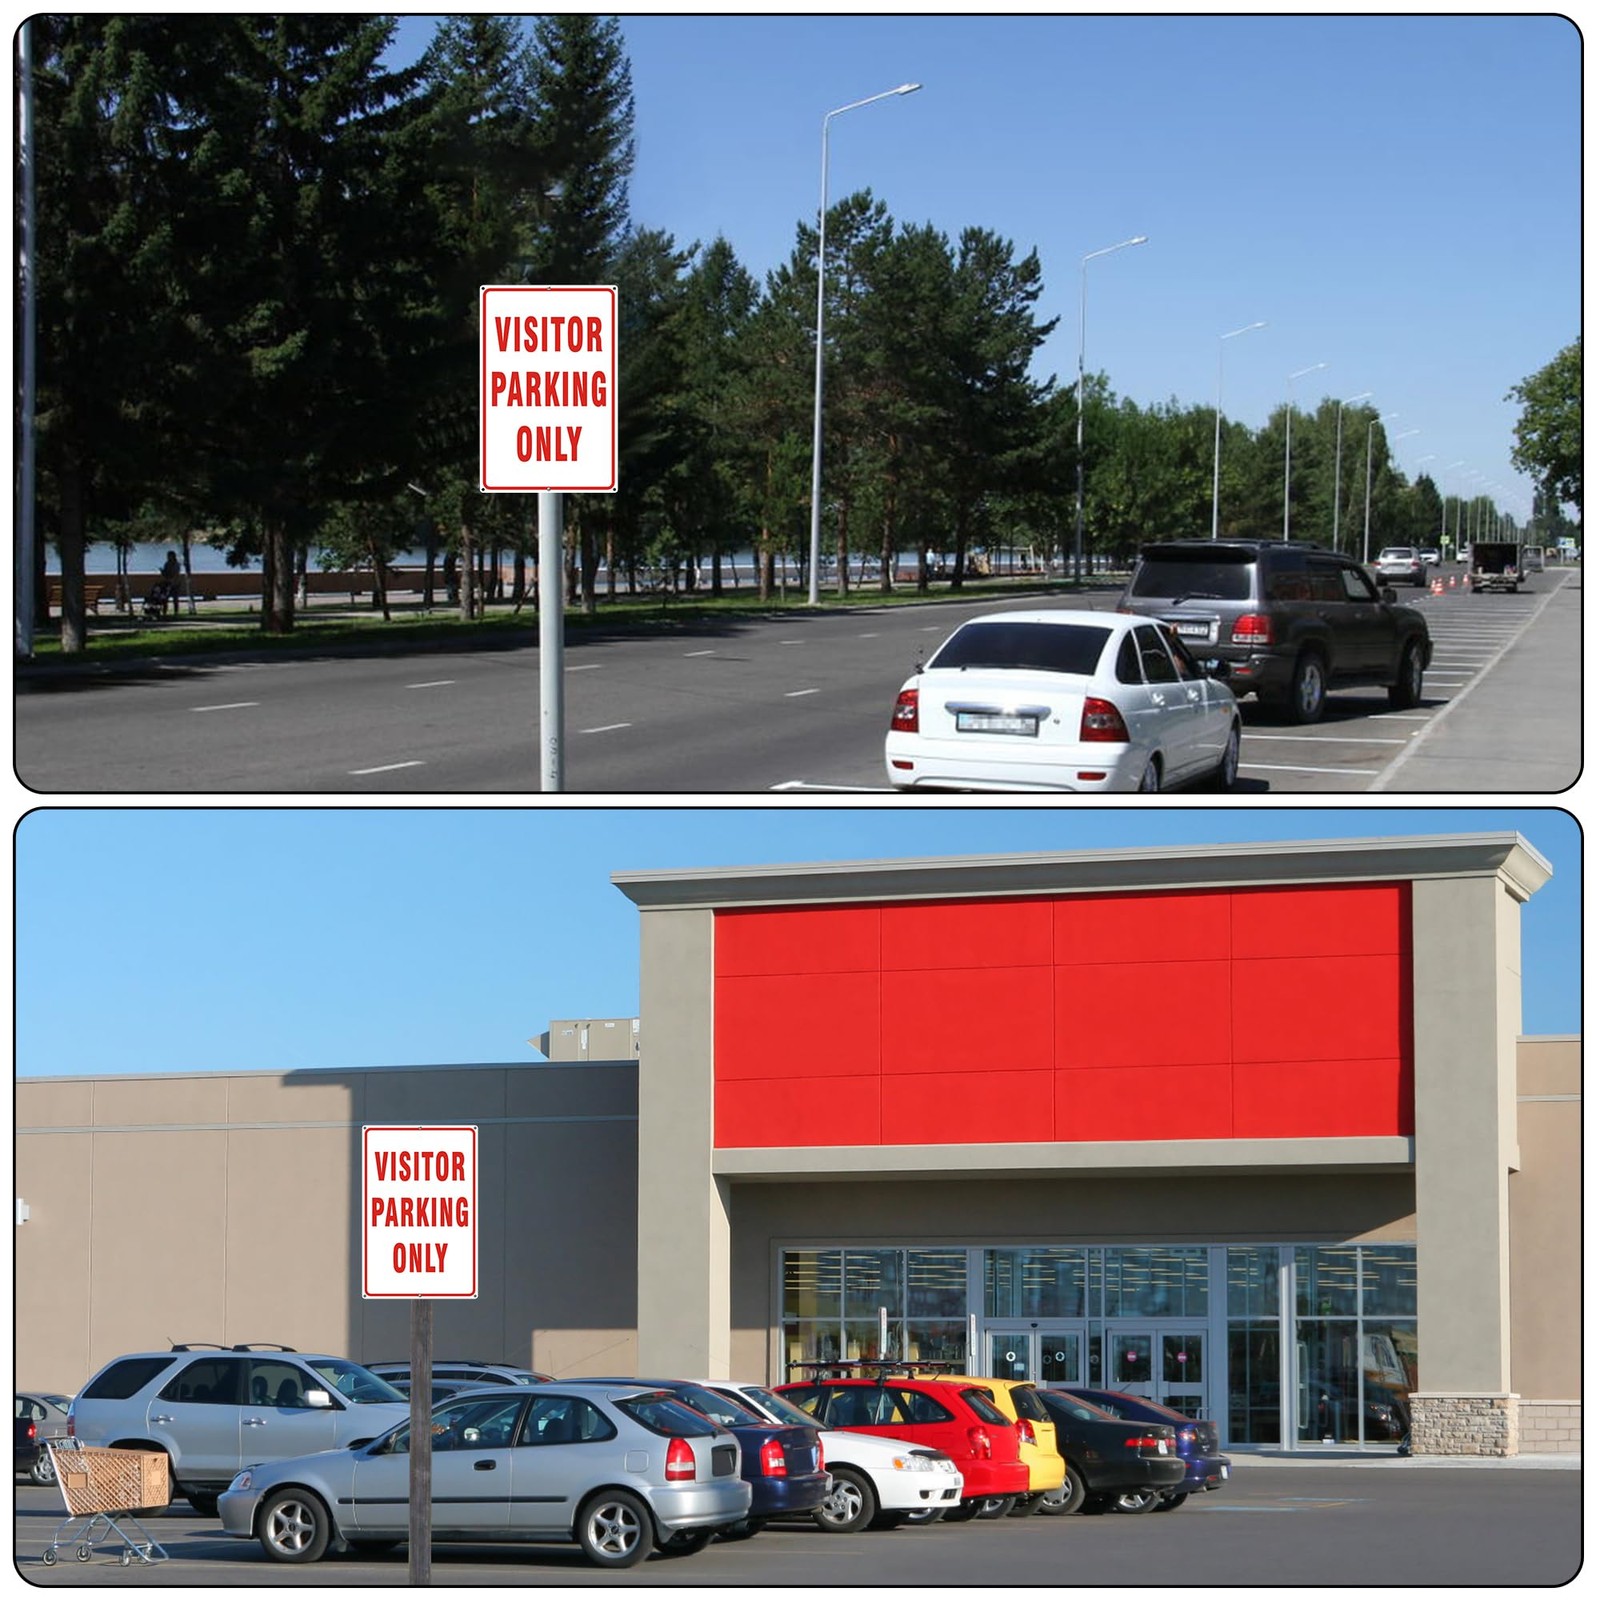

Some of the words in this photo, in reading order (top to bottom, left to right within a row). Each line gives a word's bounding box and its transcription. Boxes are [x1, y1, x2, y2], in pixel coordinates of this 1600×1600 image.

[495, 316, 603, 352] VISITOR
[491, 371, 607, 408] PARKING
[516, 425, 583, 463] ONLY
[374, 1151, 465, 1181] VISITOR
[371, 1196, 469, 1228] PARKING
[392, 1242, 449, 1274] ONLY
